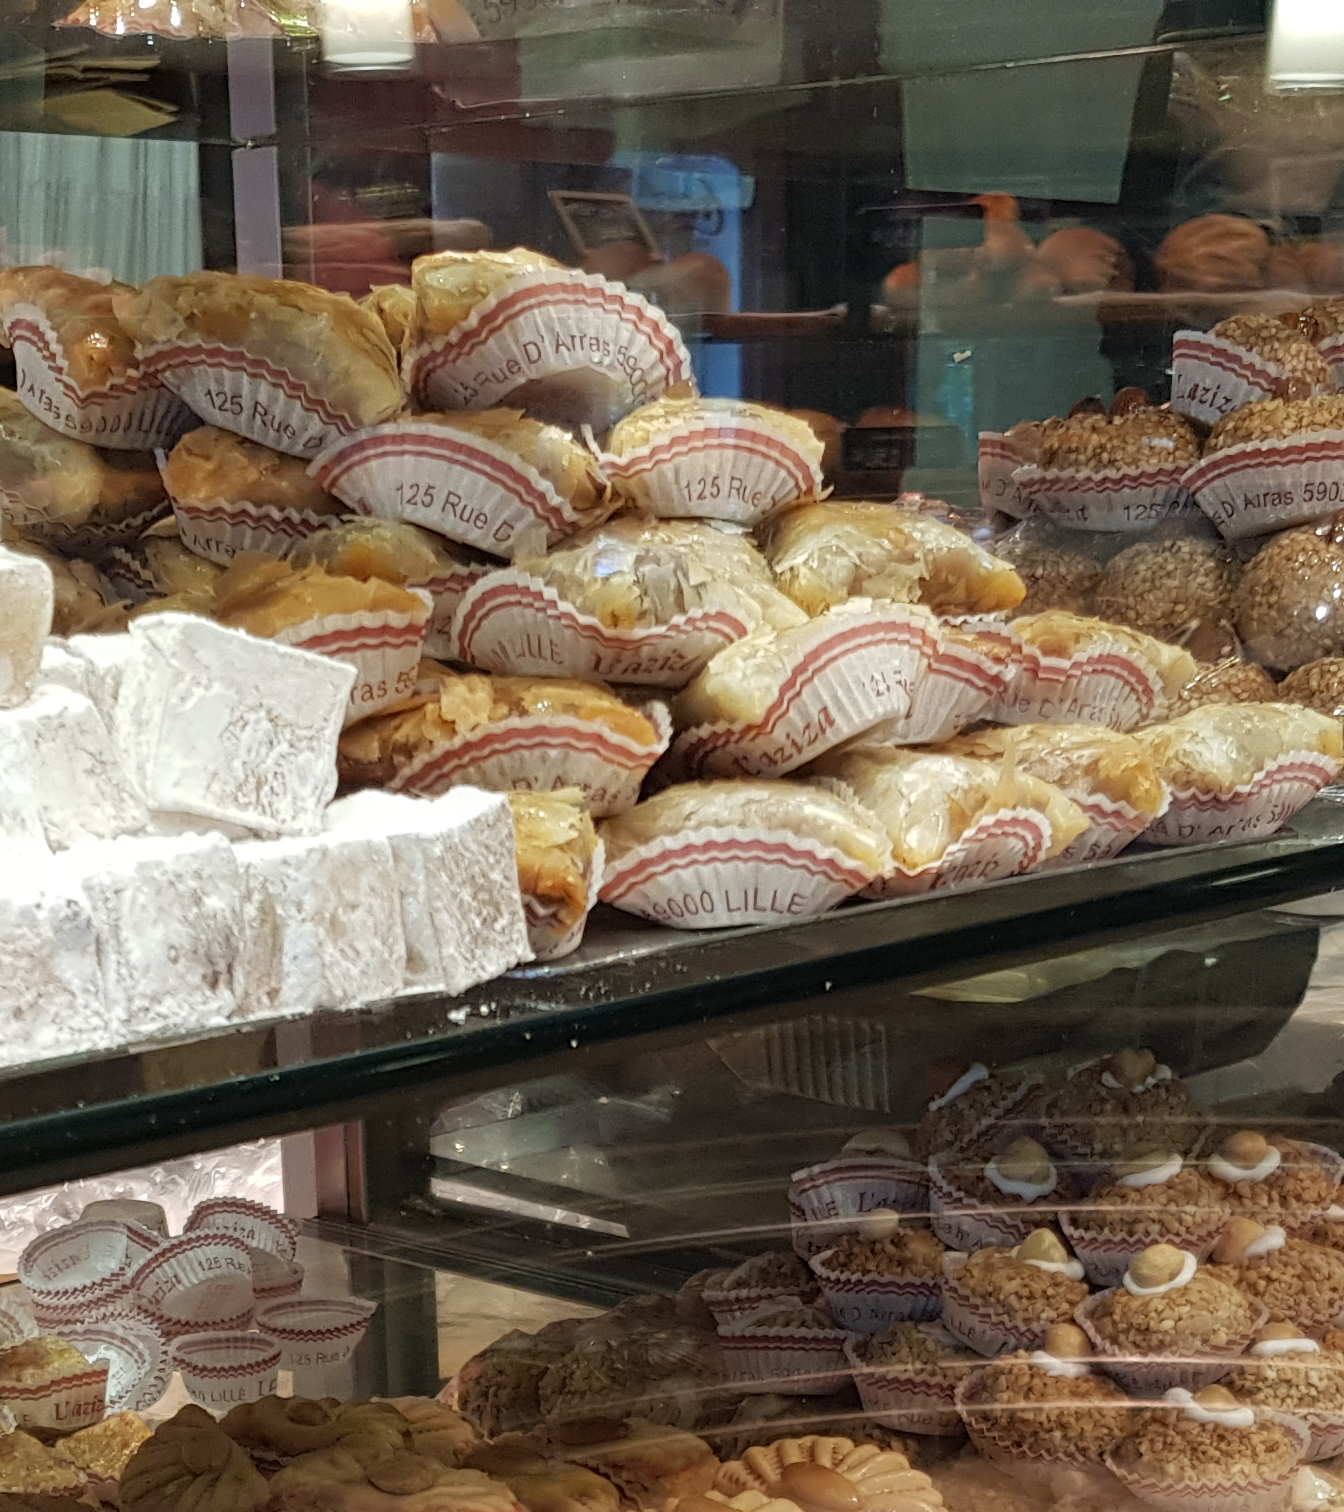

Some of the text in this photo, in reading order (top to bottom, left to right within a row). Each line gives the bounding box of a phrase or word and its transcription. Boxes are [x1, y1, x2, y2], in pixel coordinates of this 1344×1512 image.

[555, 330, 612, 357] Arras
[204, 389, 244, 415] 125
[252, 400, 297, 440] Rue
[684, 475, 722, 502] 125
[396, 481, 433, 508] 125
[441, 491, 491, 533] Rue
[724, 887, 808, 915] LILLE
